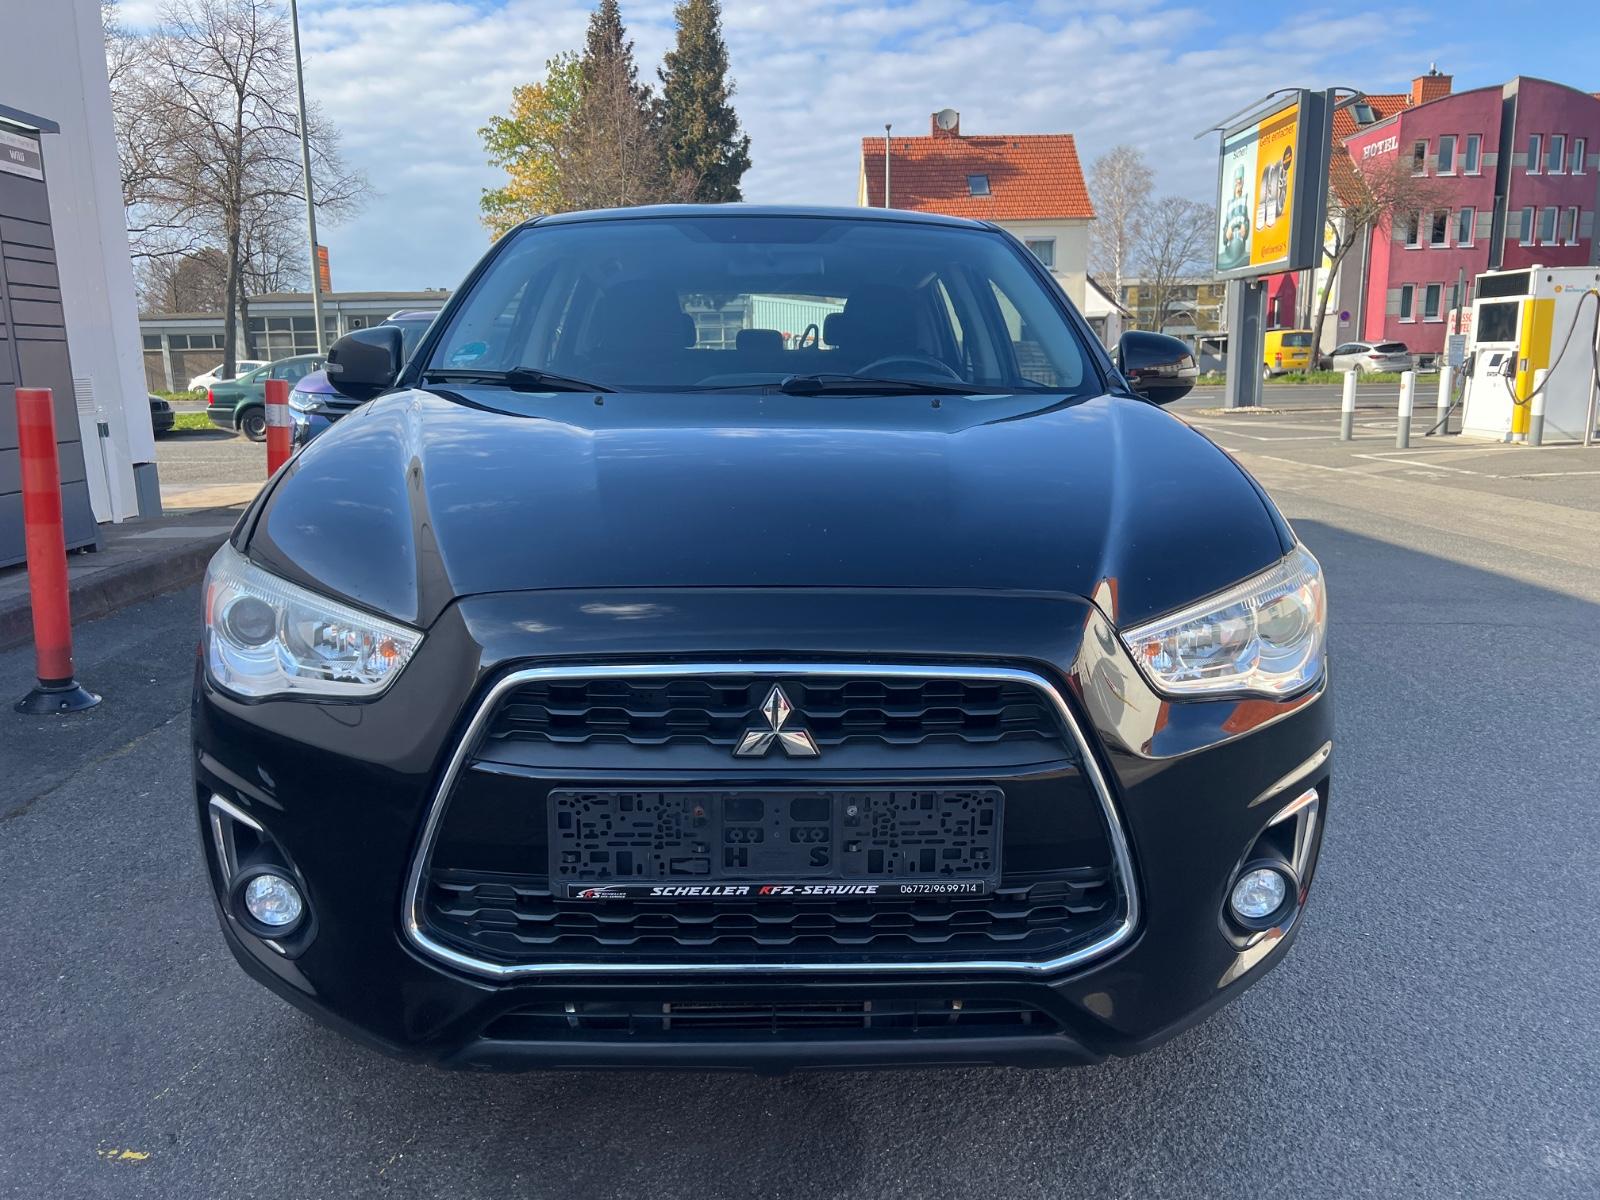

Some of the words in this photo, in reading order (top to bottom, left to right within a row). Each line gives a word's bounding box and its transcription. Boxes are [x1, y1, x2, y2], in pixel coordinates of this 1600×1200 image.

[1363, 136, 1399, 158] HOTEL
[1450, 324, 1470, 333] HTEL
[650, 887, 750, 896] SCHELLER
